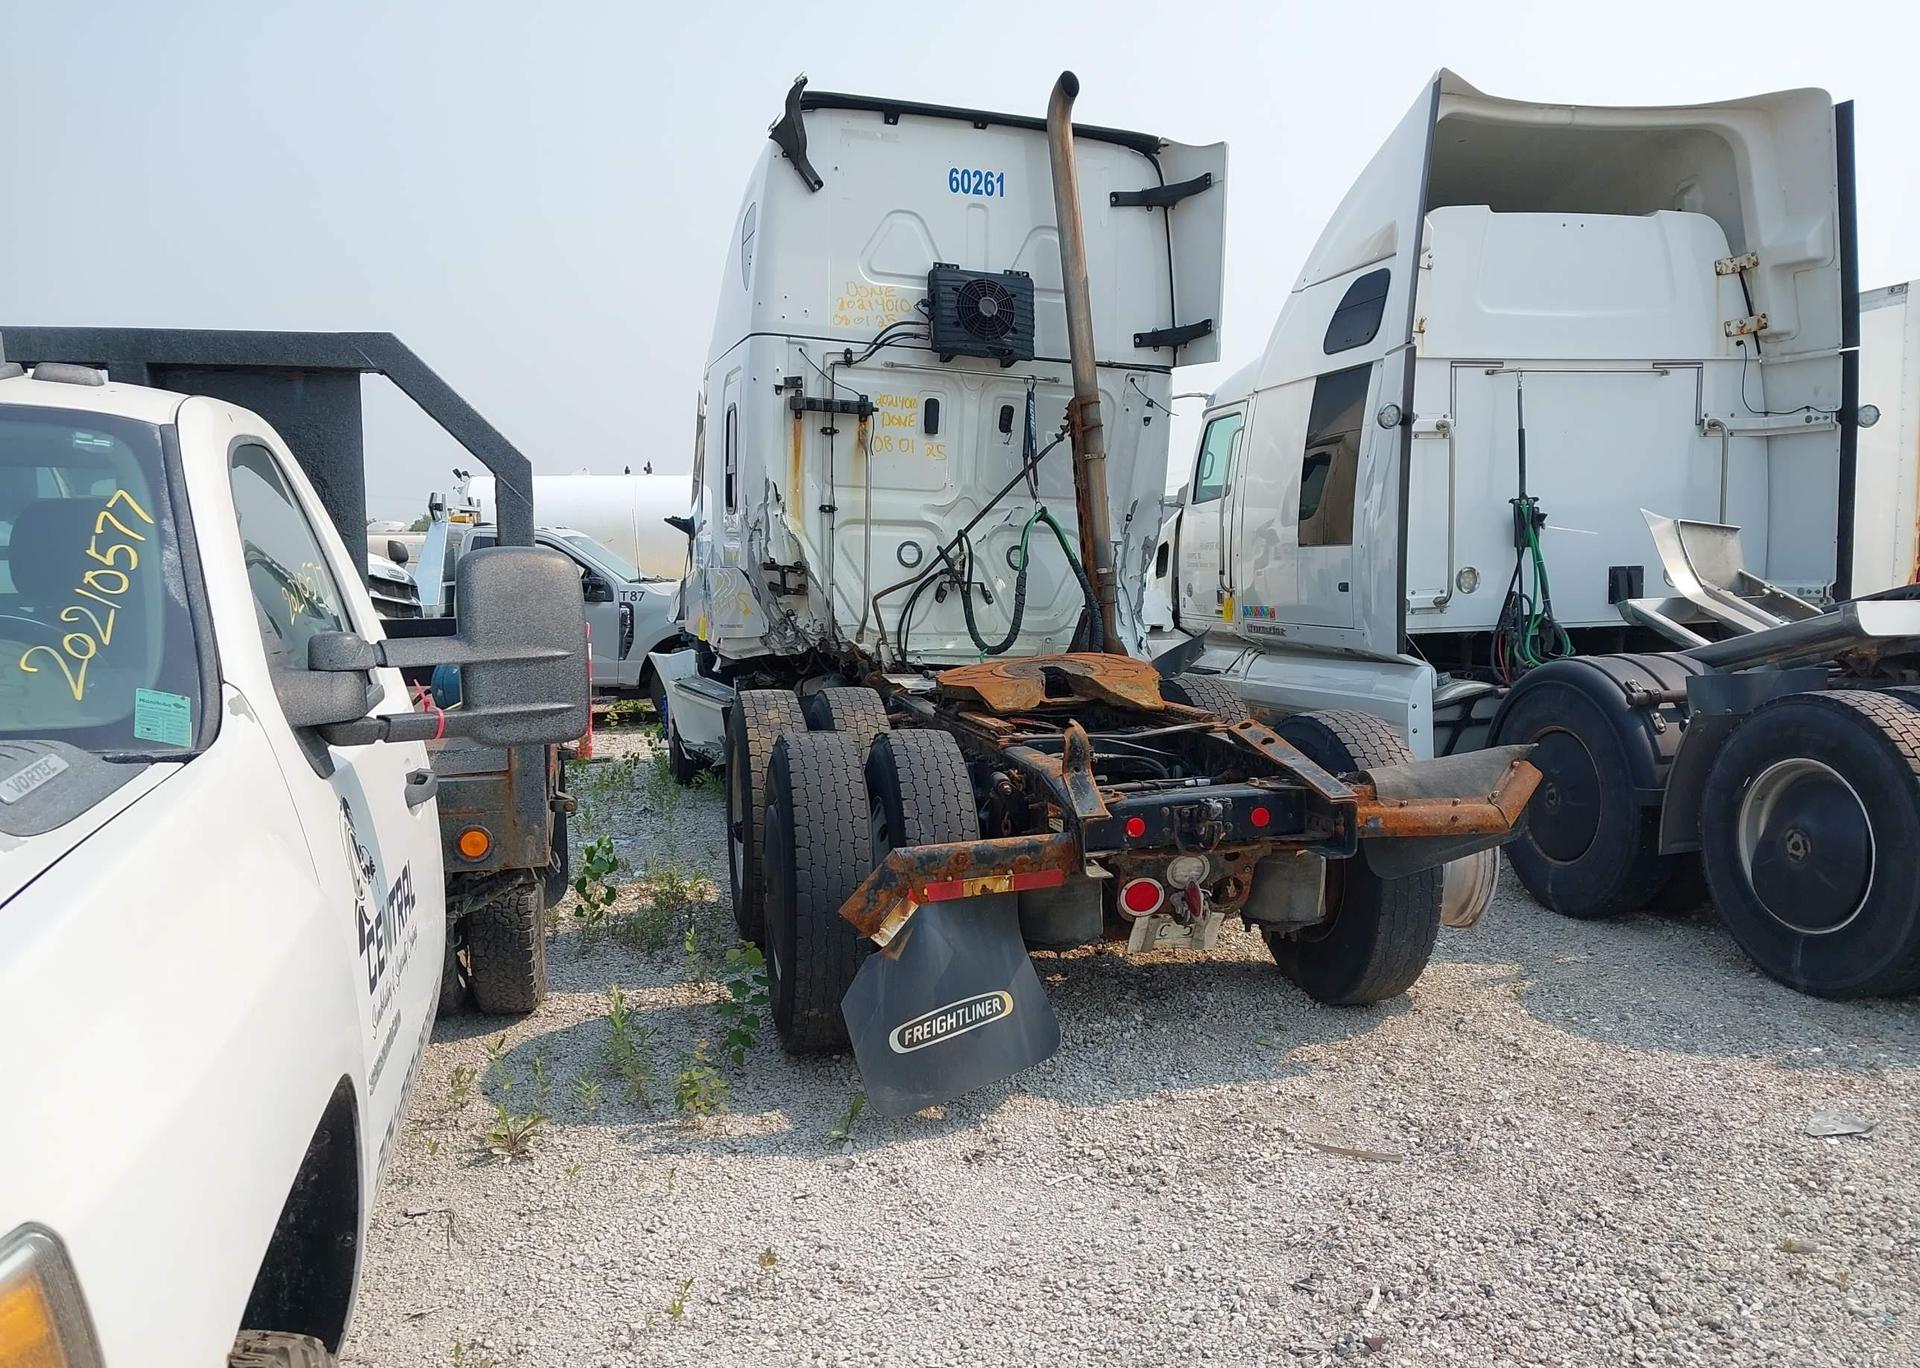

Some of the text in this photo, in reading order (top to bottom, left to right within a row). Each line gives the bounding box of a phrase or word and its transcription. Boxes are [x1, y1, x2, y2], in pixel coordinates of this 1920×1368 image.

[948, 167, 1005, 197] 60261
[881, 411, 917, 428] DONE
[18, 488, 156, 702] 20210577
[5, 758, 57, 794] VORTEC
[366, 857, 416, 997] CENTRAL
[904, 997, 1002, 1046] FREIGHTLINER
